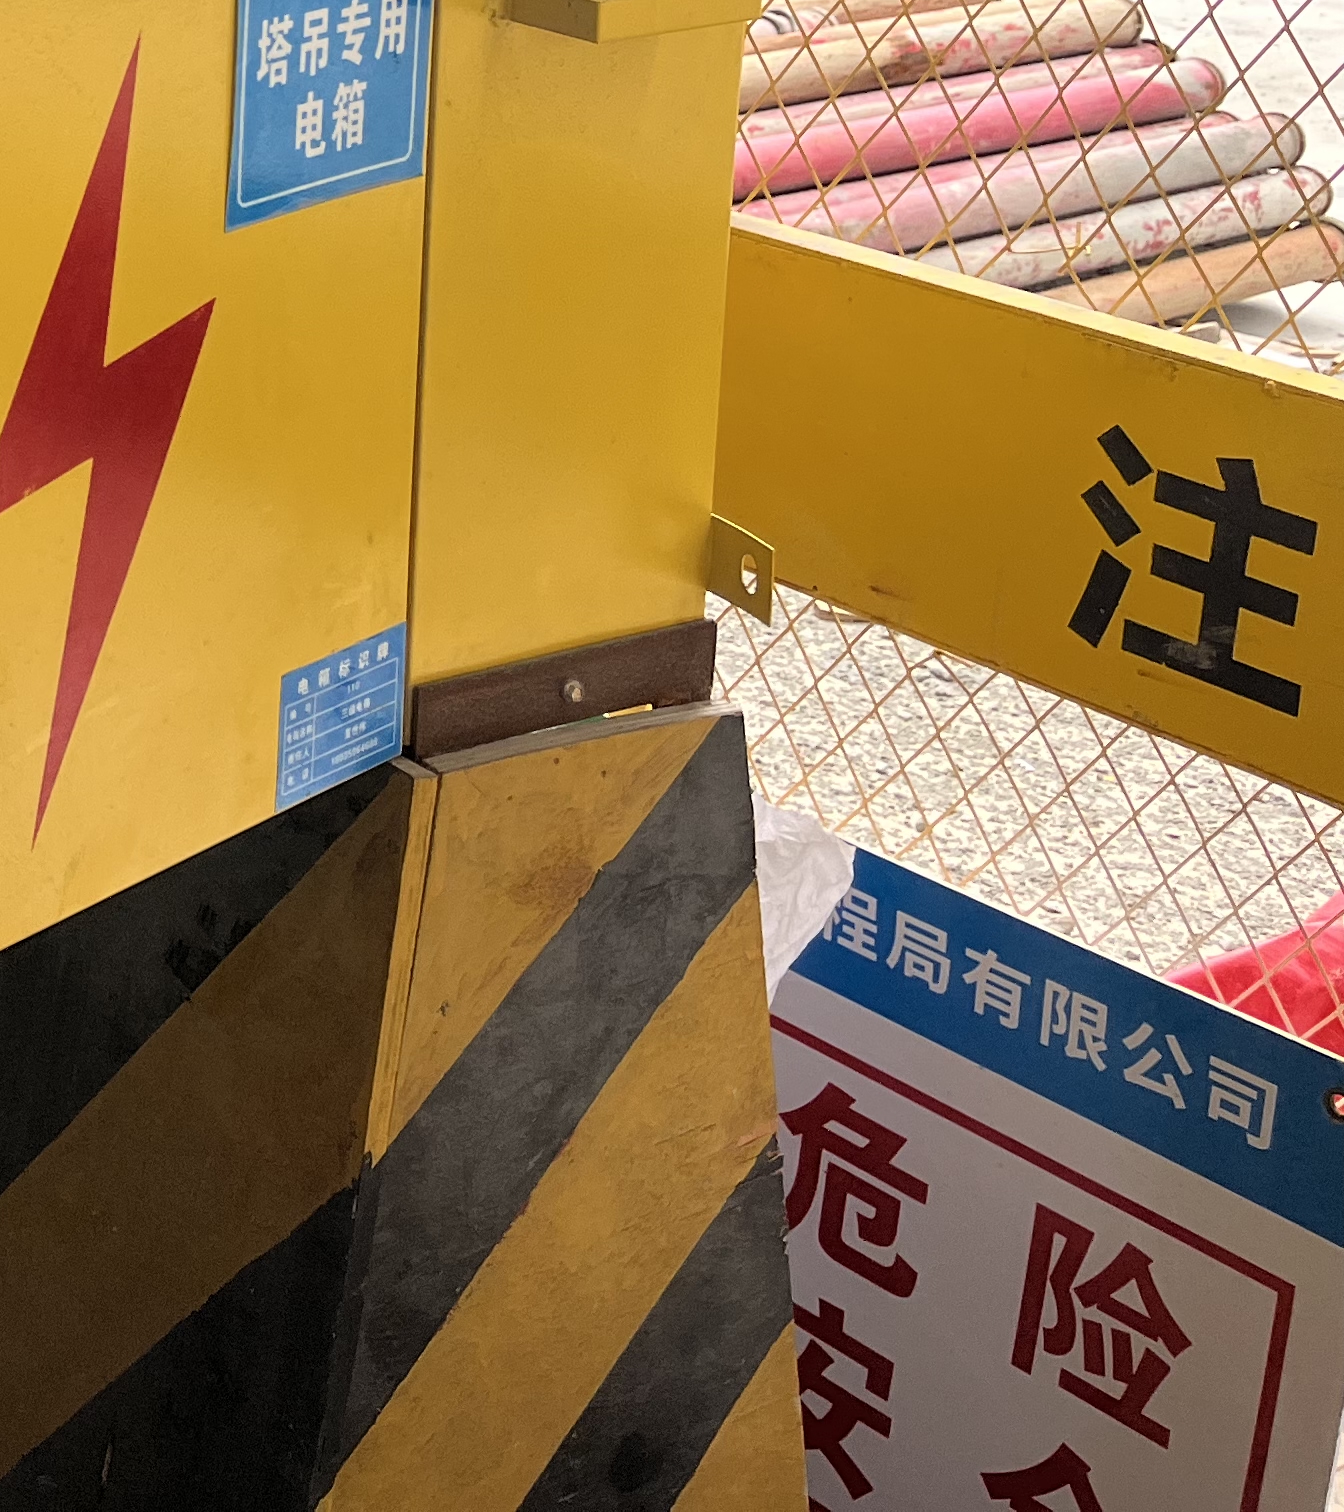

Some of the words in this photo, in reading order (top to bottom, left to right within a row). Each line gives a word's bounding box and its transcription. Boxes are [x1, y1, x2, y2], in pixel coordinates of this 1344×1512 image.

[293, 78, 368, 159] 电箱
[1067, 424, 1319, 719] 注
[822, 883, 1279, 1151] 程局有限公司
